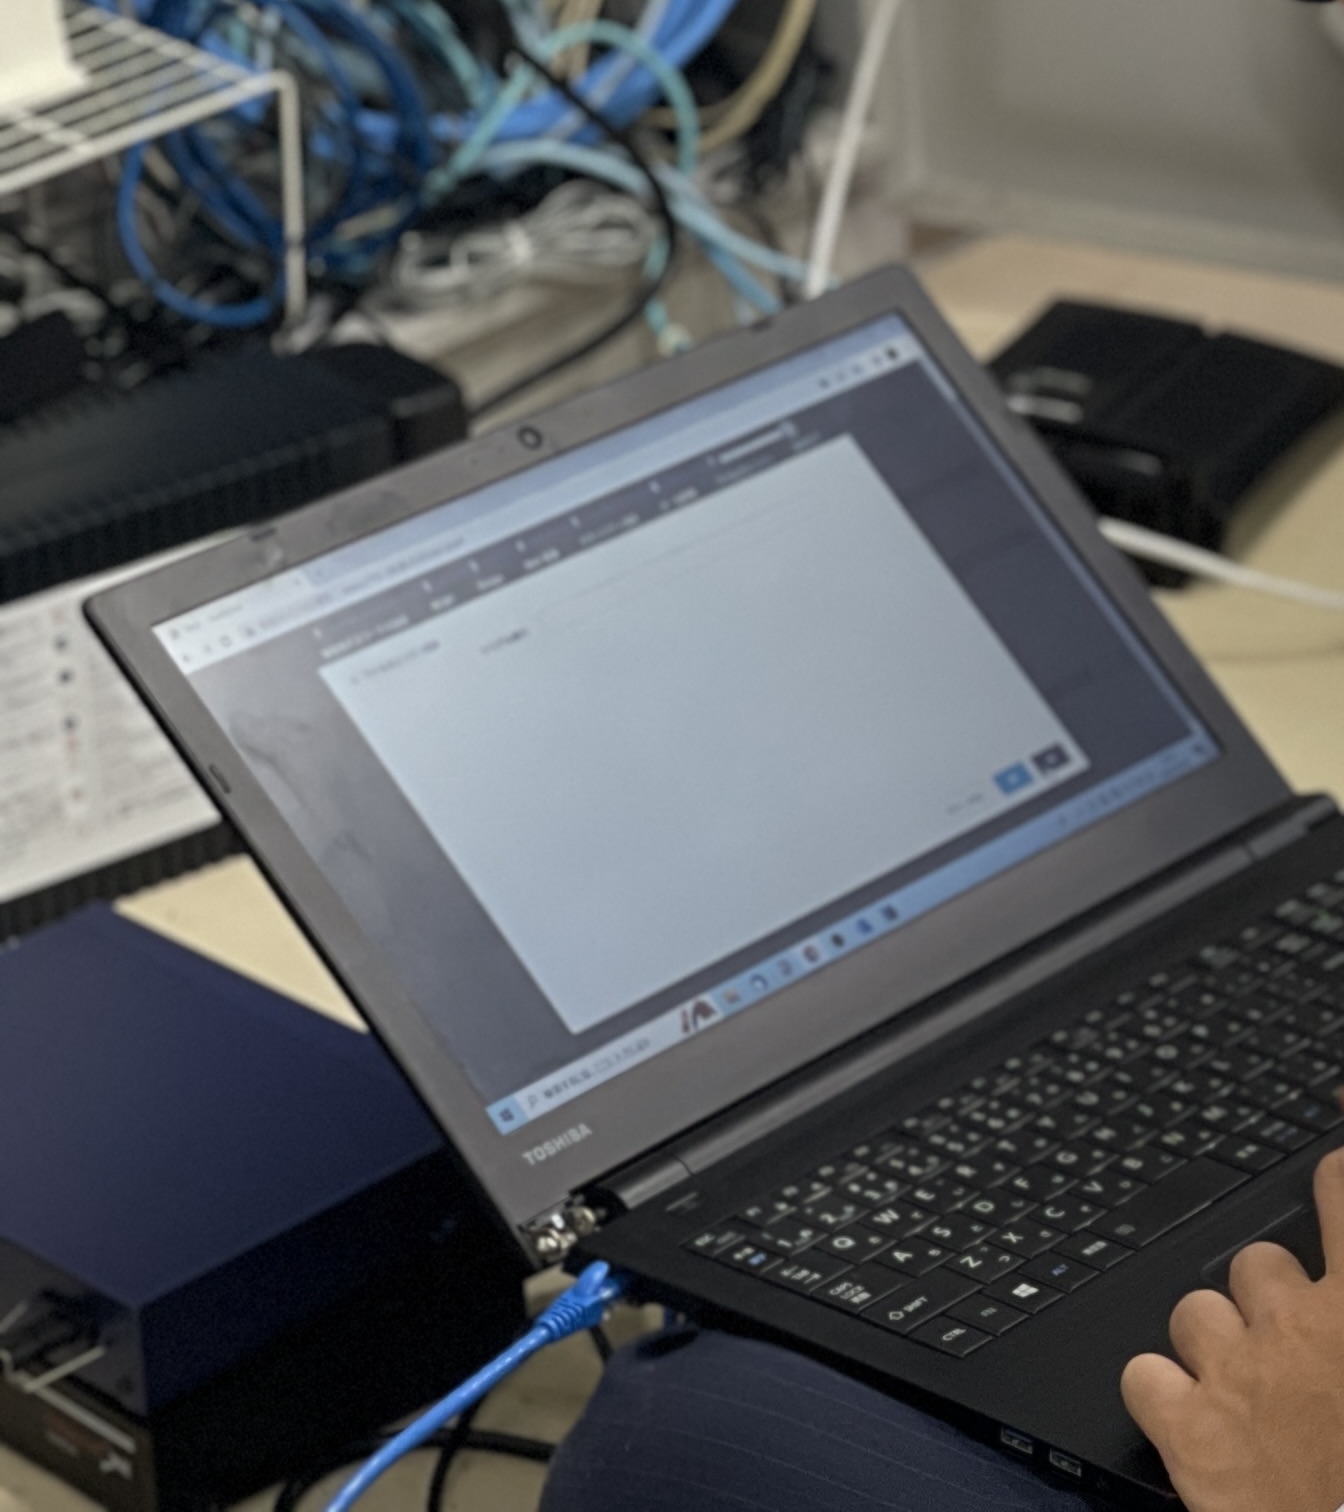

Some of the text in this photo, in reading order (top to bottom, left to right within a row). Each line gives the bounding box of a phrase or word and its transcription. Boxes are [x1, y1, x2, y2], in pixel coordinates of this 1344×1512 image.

[523, 1123, 592, 1165] TOSHIBA
[1012, 1177, 1030, 1190] F
[1082, 1179, 1104, 1193] V
[913, 1188, 936, 1202] E
[872, 1208, 900, 1226] W
[1044, 1206, 1066, 1220] C
[931, 1226, 952, 1239] S
[1001, 1231, 1024, 1245] X
[892, 1250, 913, 1263] A
[959, 1255, 983, 1269] Z
